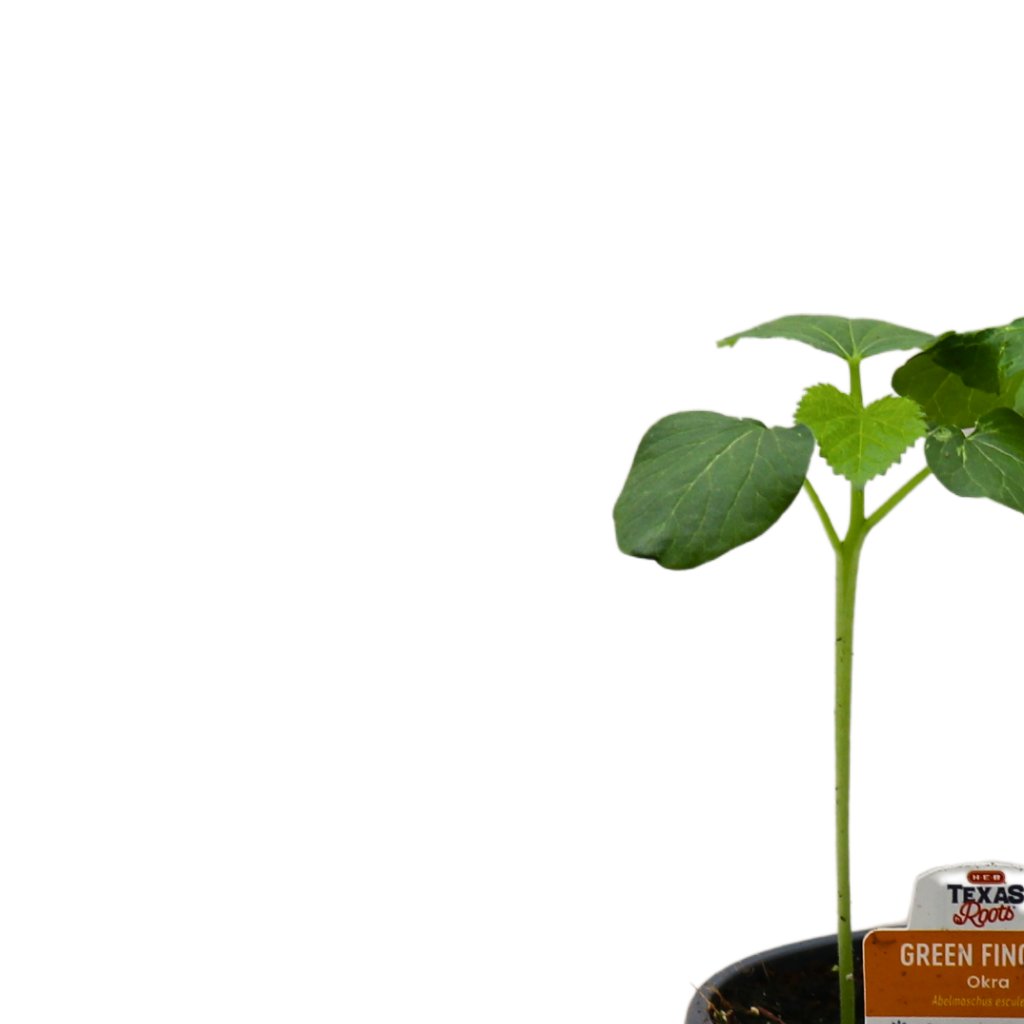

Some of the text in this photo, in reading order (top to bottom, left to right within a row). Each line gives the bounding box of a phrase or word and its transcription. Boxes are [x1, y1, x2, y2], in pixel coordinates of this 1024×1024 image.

[947, 884, 1024, 904] TEXAS
[953, 901, 1014, 928] Roots
[900, 943, 973, 967] GREEN
[967, 975, 1010, 989] Okra
